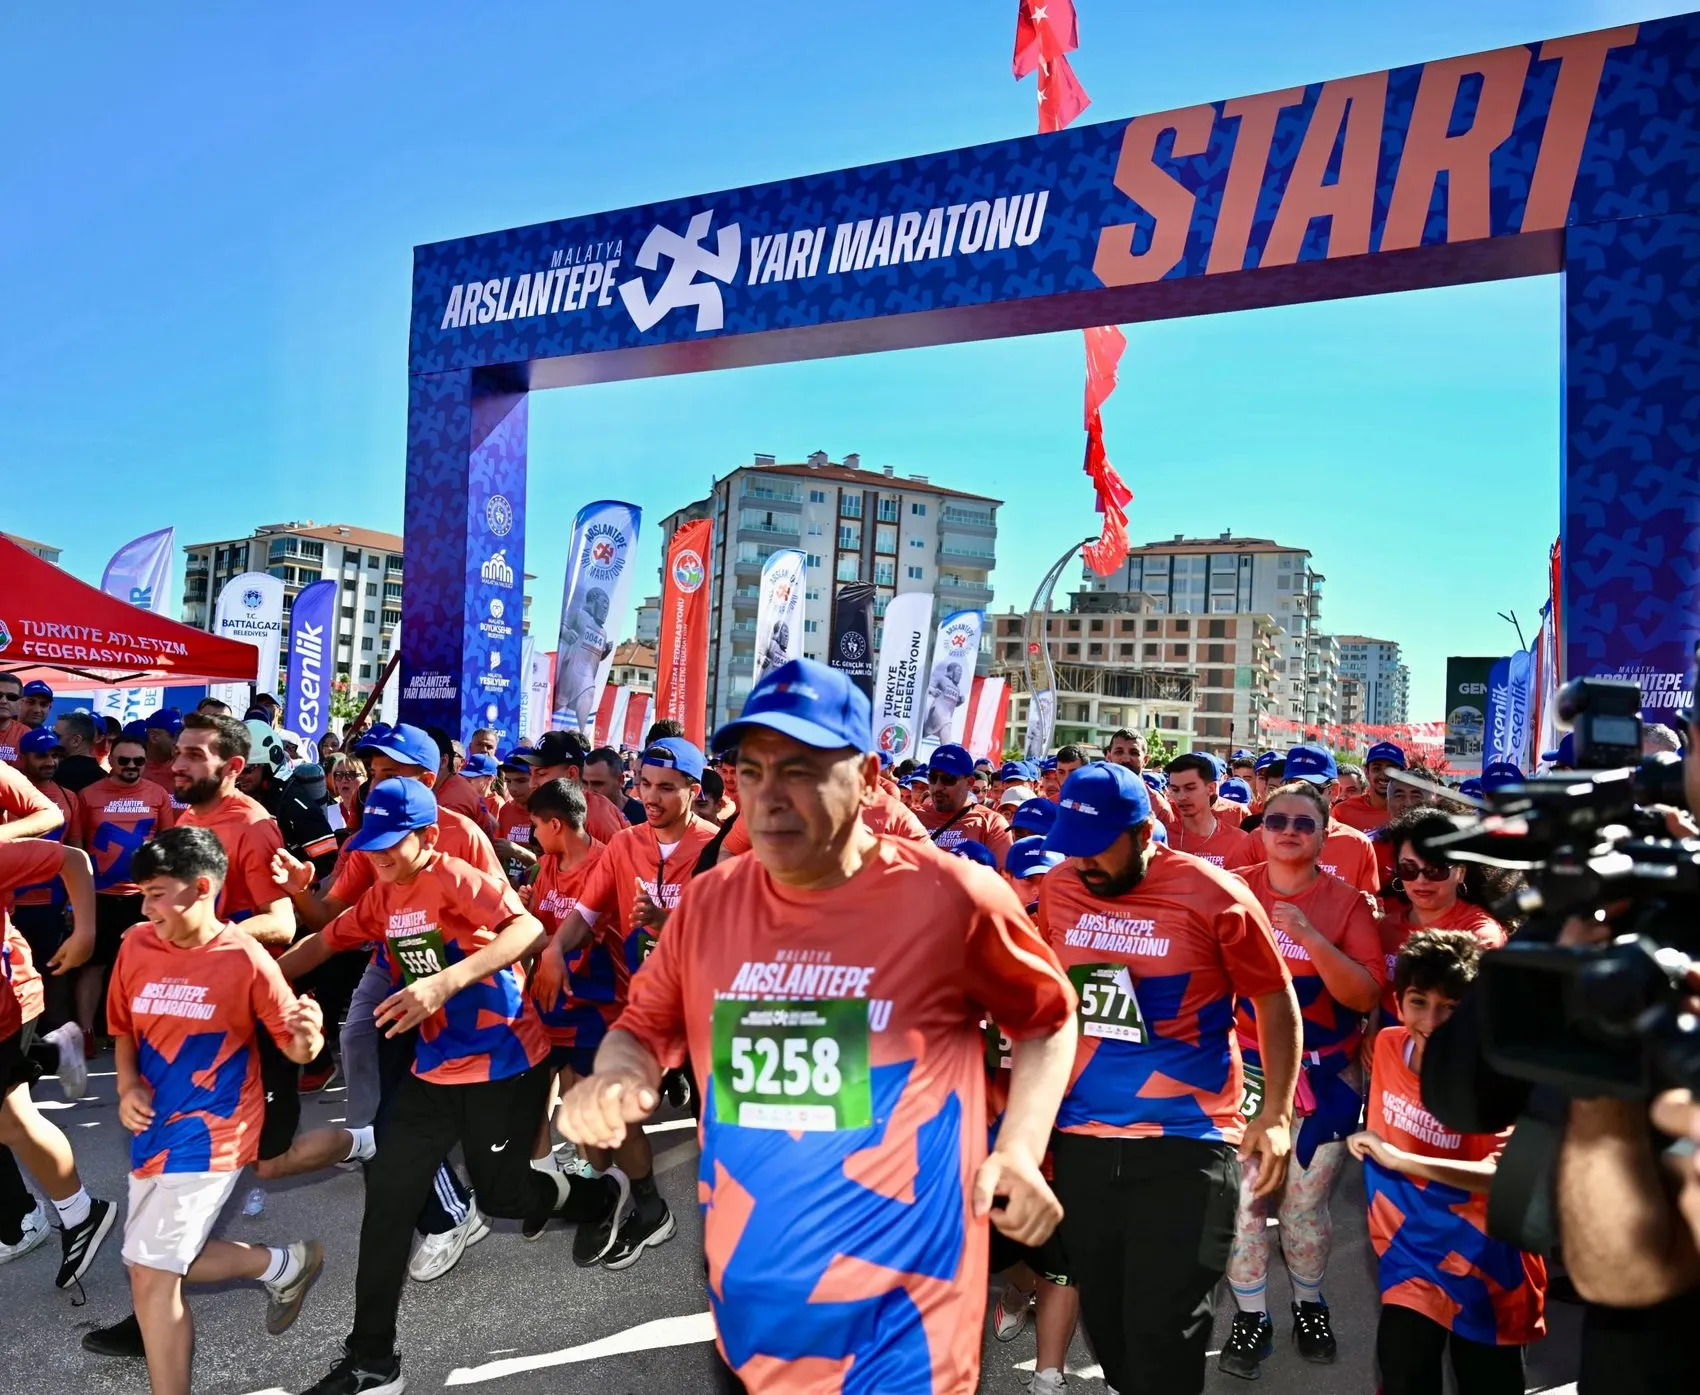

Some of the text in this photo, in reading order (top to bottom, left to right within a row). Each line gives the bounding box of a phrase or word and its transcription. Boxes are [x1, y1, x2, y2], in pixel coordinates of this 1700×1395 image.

[1092, 23, 1640, 288] START
[550, 239, 623, 268] MALATYA
[747, 190, 1049, 286] YARI MARATONU
[440, 259, 621, 330] ARSLANTEPE
[584, 523, 628, 549] ARSLANTEPE
[673, 597, 685, 665] FEDERASYONU
[295, 621, 324, 734] esenlik
[403, 687, 457, 699] YARI MARATONU
[410, 675, 452, 688] ARSLANTEPE
[902, 631, 922, 719] FEDERASYONU
[1491, 682, 1508, 752] esenlik
[1511, 675, 1526, 749] esenlik
[1640, 691, 1694, 708] RATONU
[1065, 929, 1170, 957] YARI MARATONU
[1076, 913, 1155, 937] ARSLANTEPE
[776, 949, 832, 963] MALATYA
[731, 961, 876, 998] ARSLANTEPE
[150, 998, 216, 1020] MARATONU
[731, 1036, 842, 1097] 5258
[1394, 1113, 1462, 1149] MARATONU
